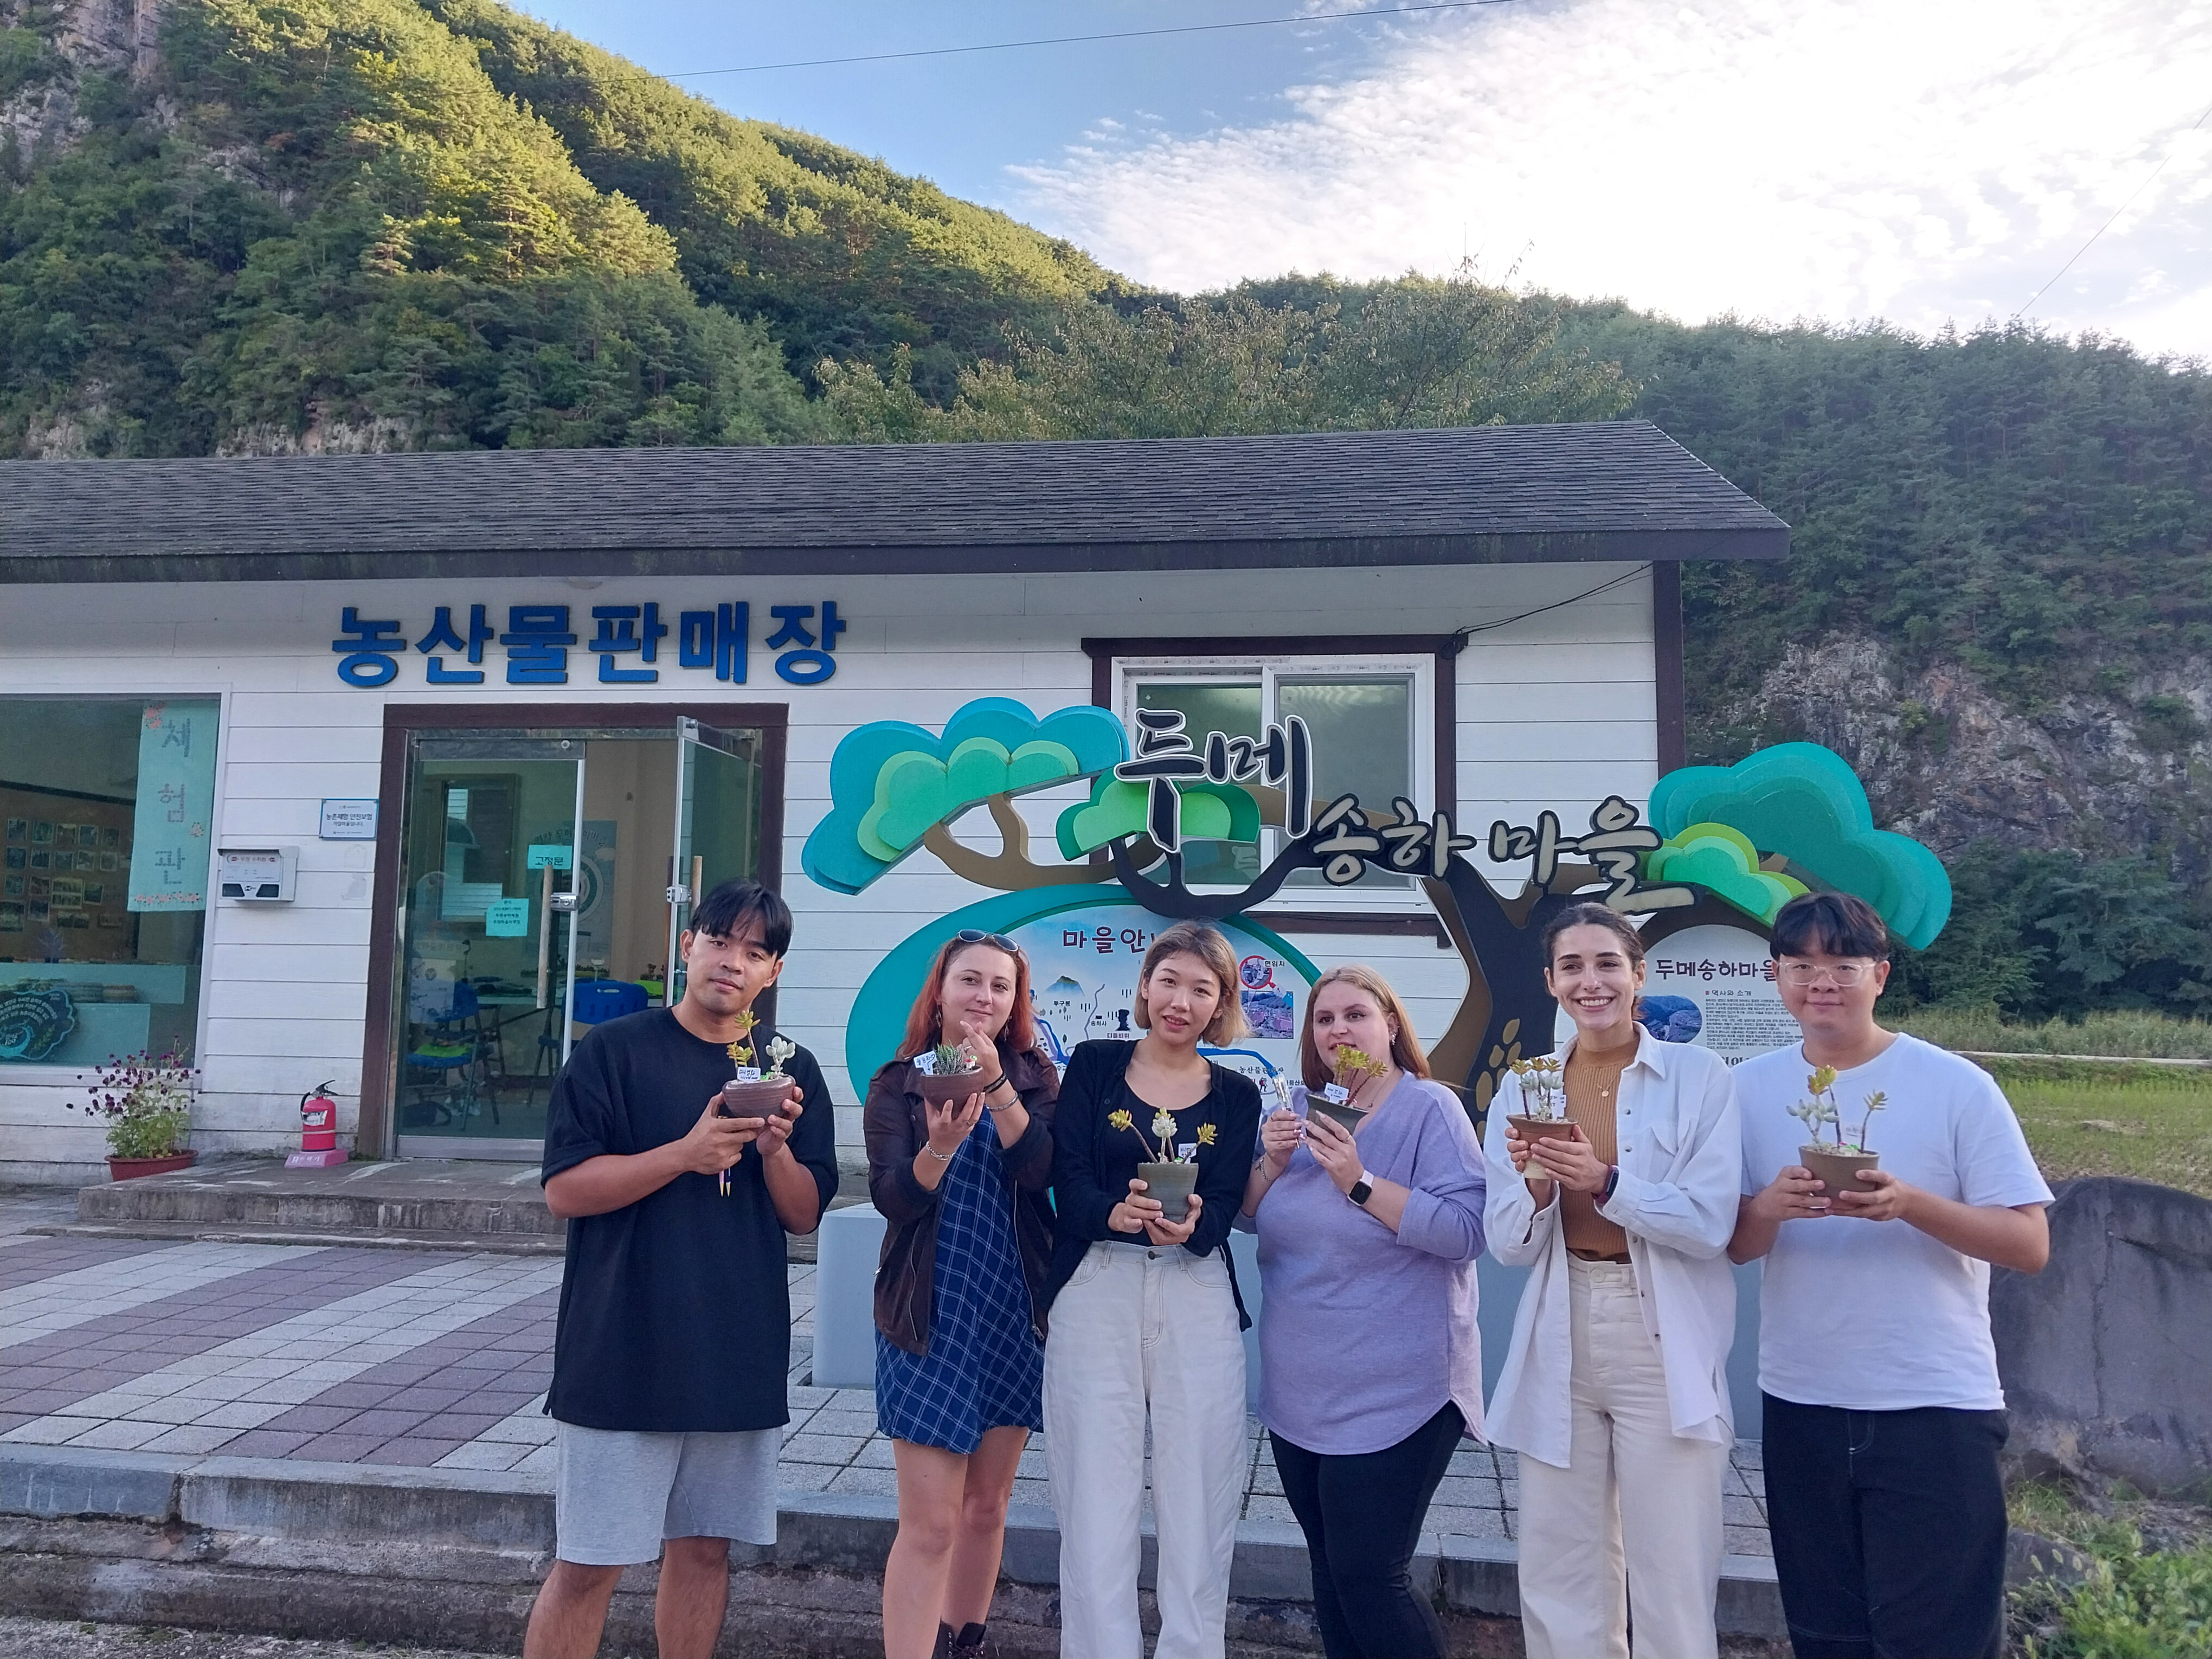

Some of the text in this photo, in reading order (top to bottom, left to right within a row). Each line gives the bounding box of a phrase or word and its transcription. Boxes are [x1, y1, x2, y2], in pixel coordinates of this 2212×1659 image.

[332, 601, 846, 687] 농산물판매장
[155, 718, 191, 885] 체험관
[1115, 708, 1313, 853] 두메
[535, 856, 563, 866] 고정문
[1063, 926, 1155, 954] 마을안
